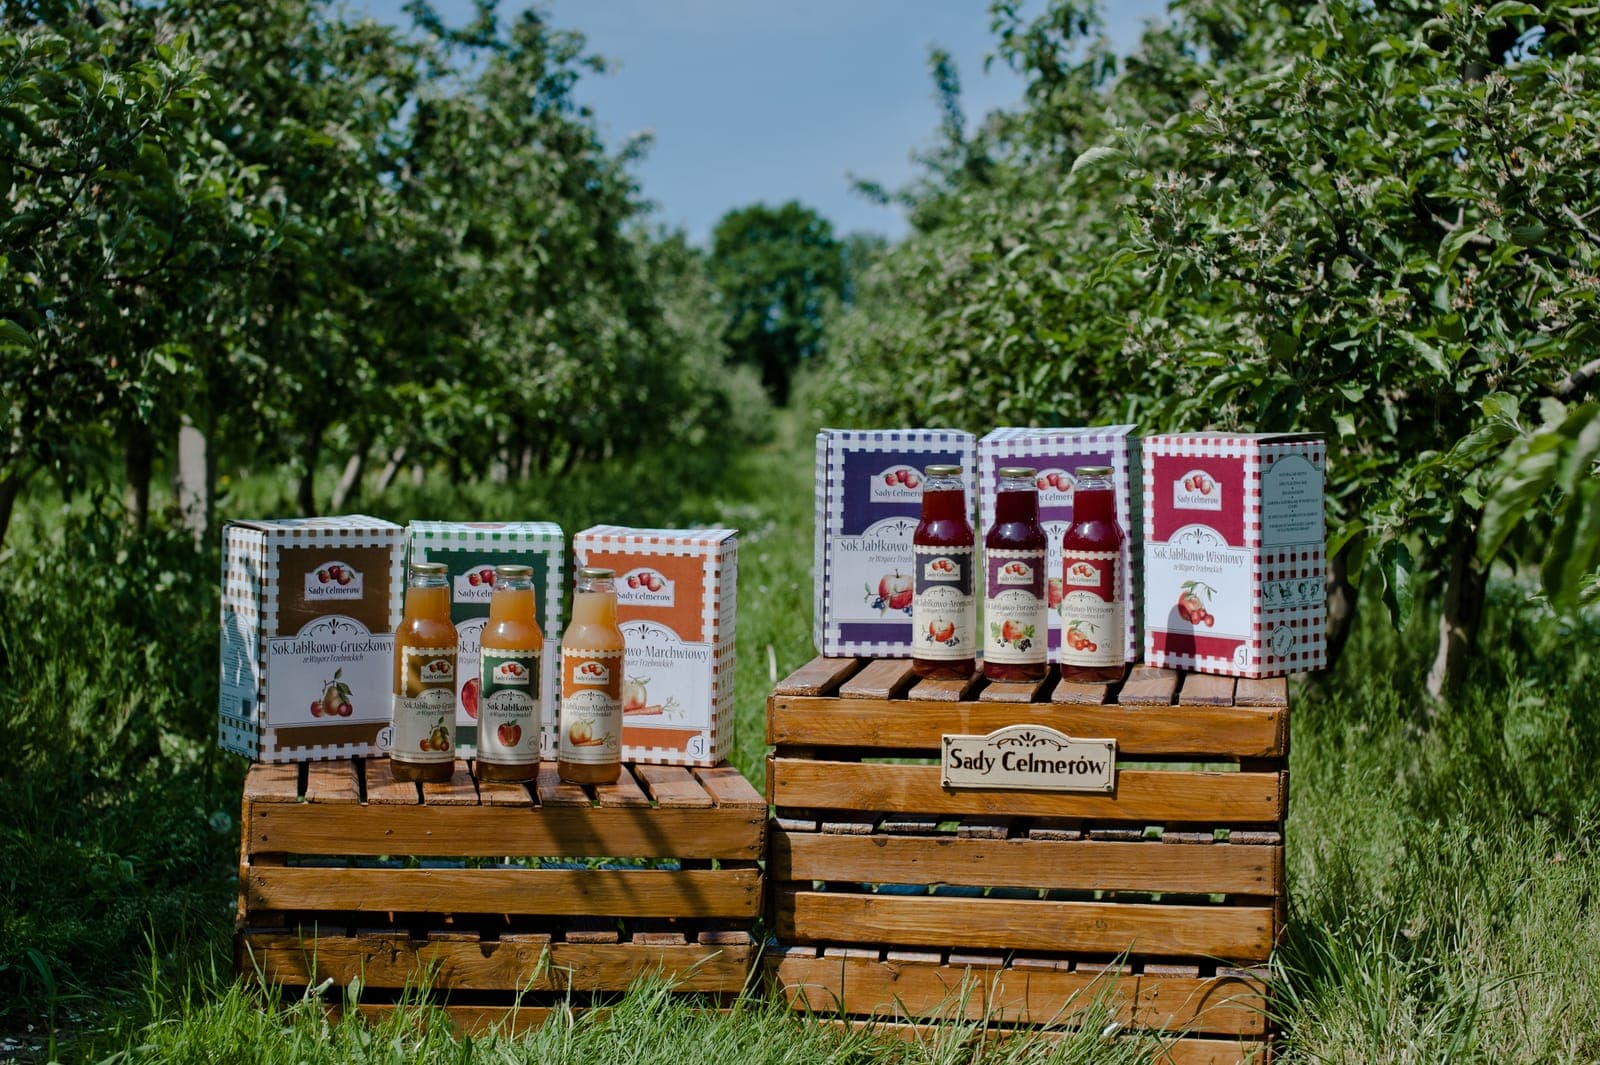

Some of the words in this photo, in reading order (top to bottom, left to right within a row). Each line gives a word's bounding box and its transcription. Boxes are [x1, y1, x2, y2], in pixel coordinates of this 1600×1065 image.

[874, 489, 891, 498] Sady
[841, 540, 858, 552] Sok
[1153, 547, 1167, 560] Sok
[308, 586, 325, 596] Sady
[458, 589, 475, 598] Sady
[617, 591, 634, 601] Sady
[272, 641, 290, 655] Sok
[487, 702, 499, 711] Sok
[500, 702, 533, 713] Jabłkowy
[950, 748, 995, 775] Sady
[1002, 750, 1107, 776] Celmerów
